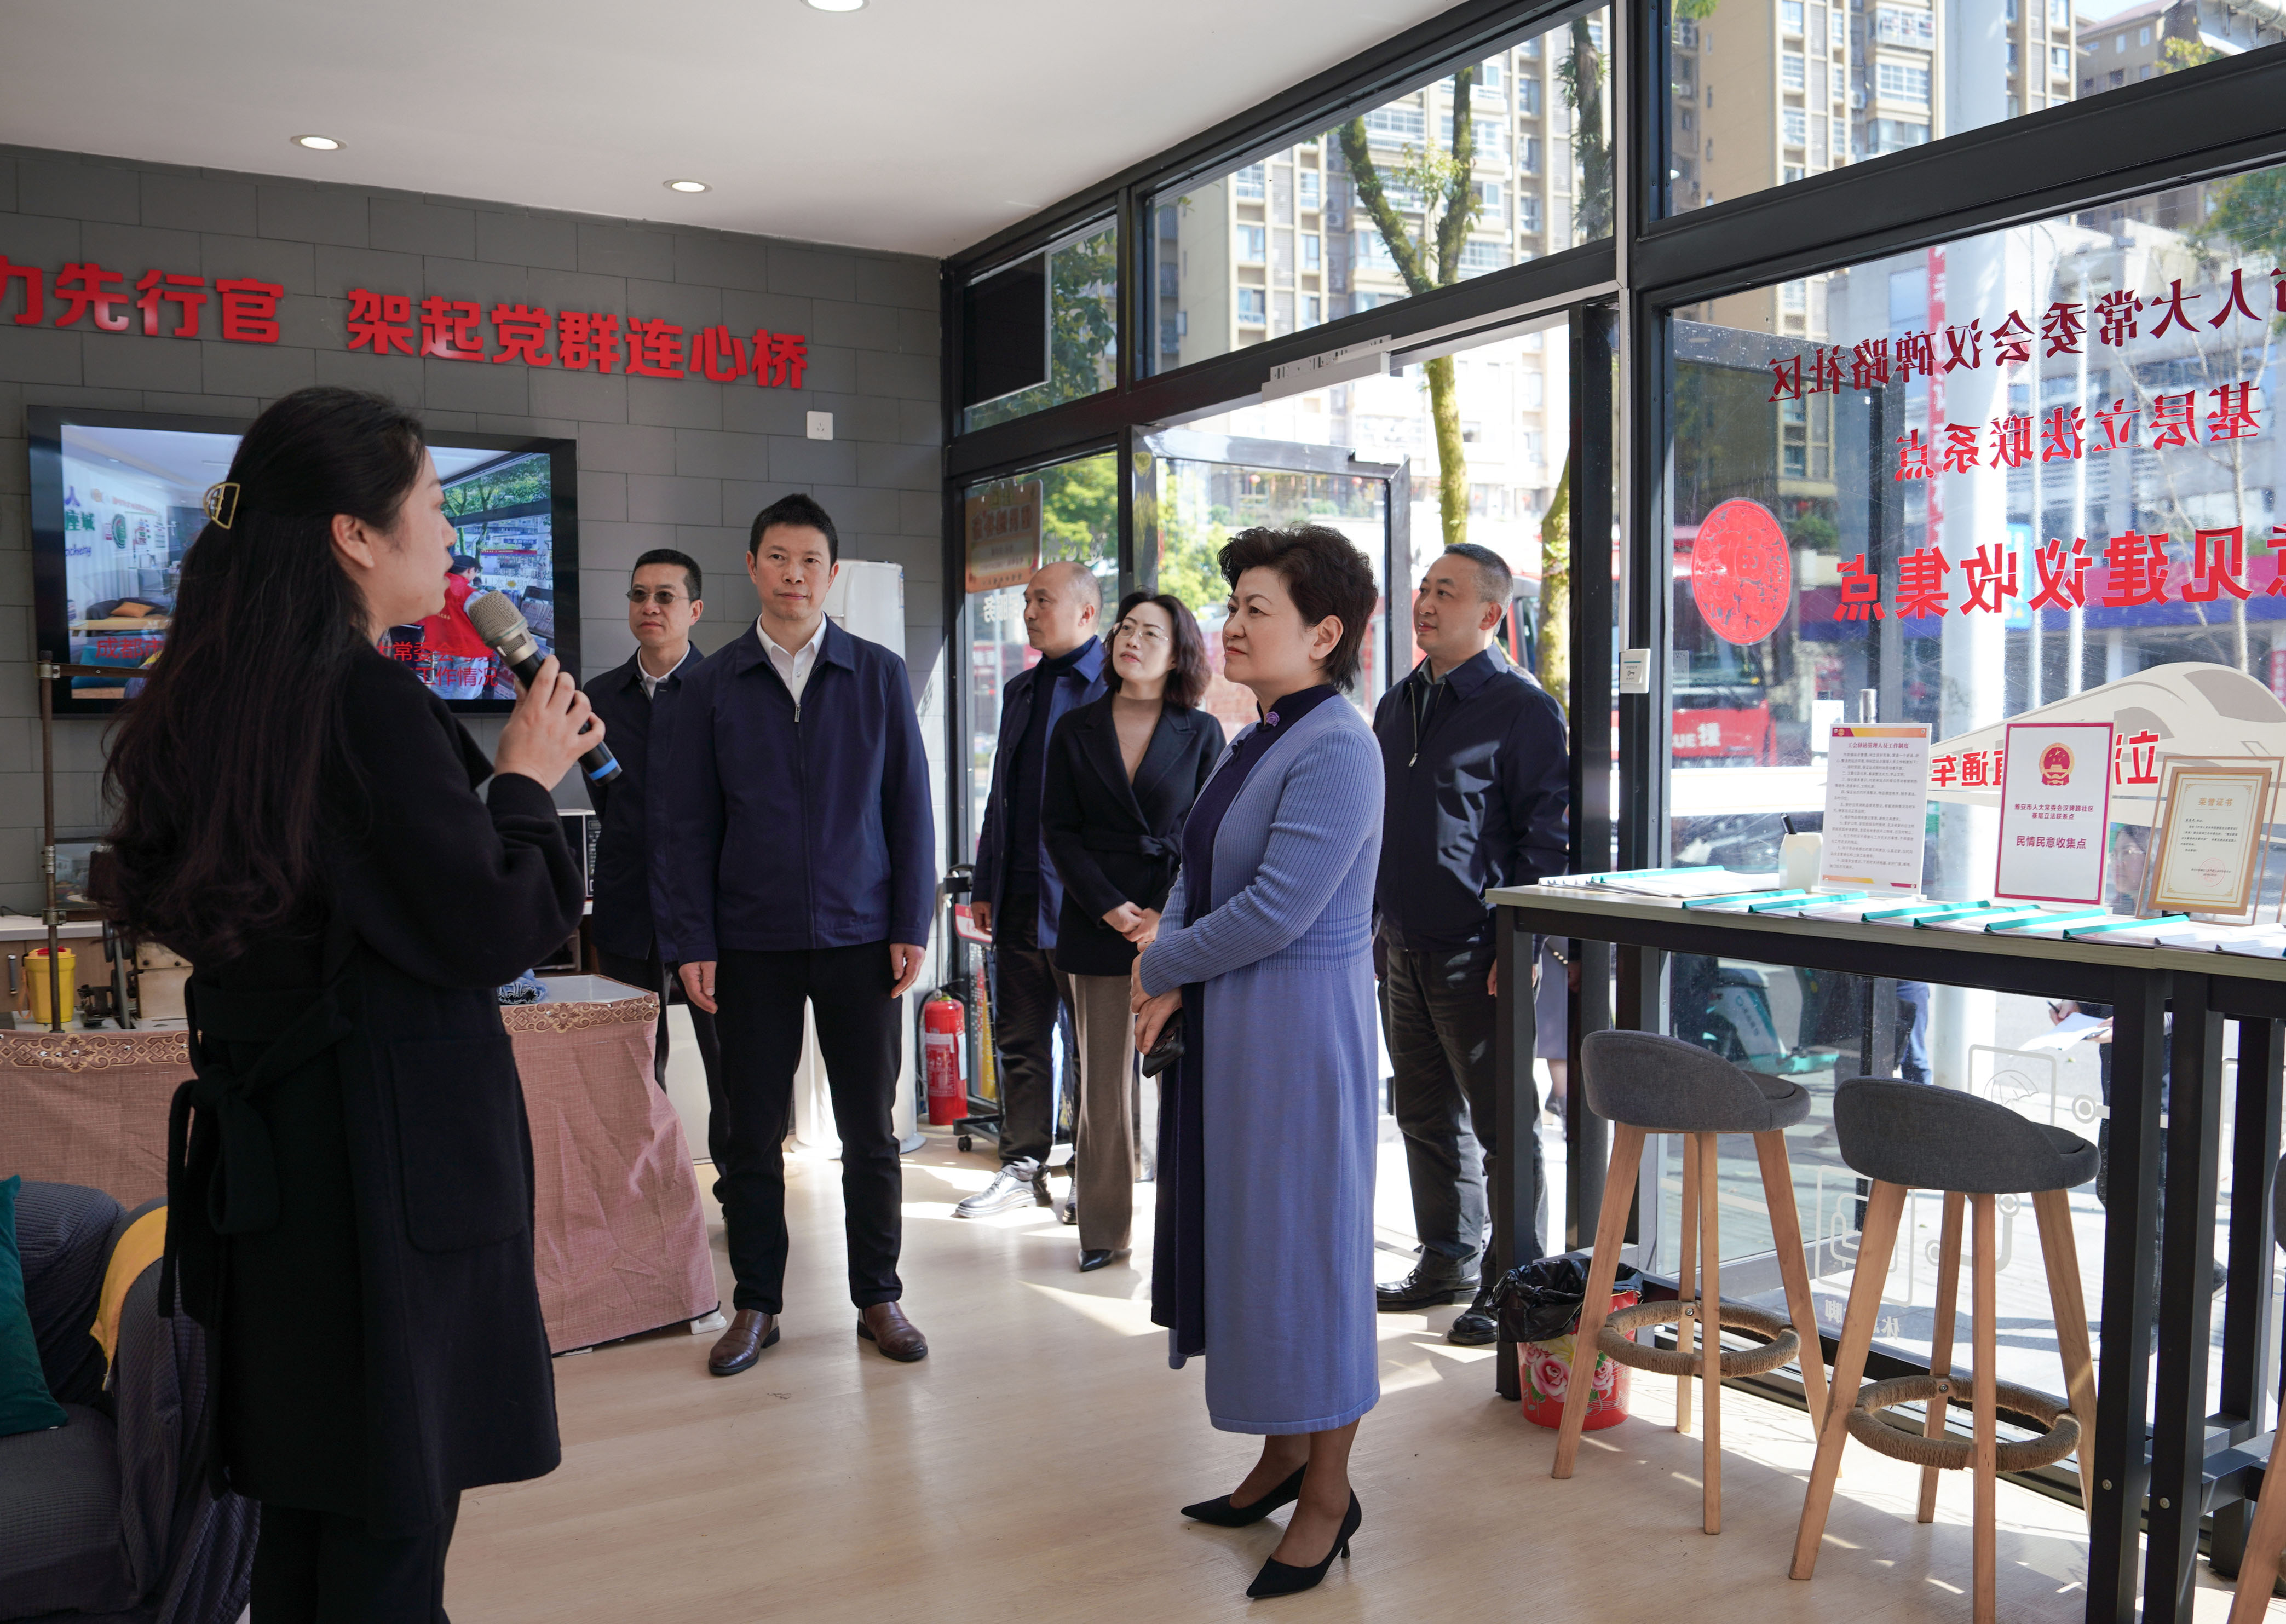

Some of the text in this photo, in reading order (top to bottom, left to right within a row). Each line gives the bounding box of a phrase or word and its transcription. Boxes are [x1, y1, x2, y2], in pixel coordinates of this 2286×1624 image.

[0, 255, 808, 389] 力先行官 架起党群连心桥
[95, 636, 166, 659] 成都市
[410, 666, 499, 687] 工作情况
[2014, 803, 2094, 813] 雅安市人大常委会汉碑路社区
[2197, 797, 2233, 807] 荣誉证书
[2032, 812, 2075, 820] 基层立法联系点
[2016, 835, 2087, 850] 民情民意收集点
